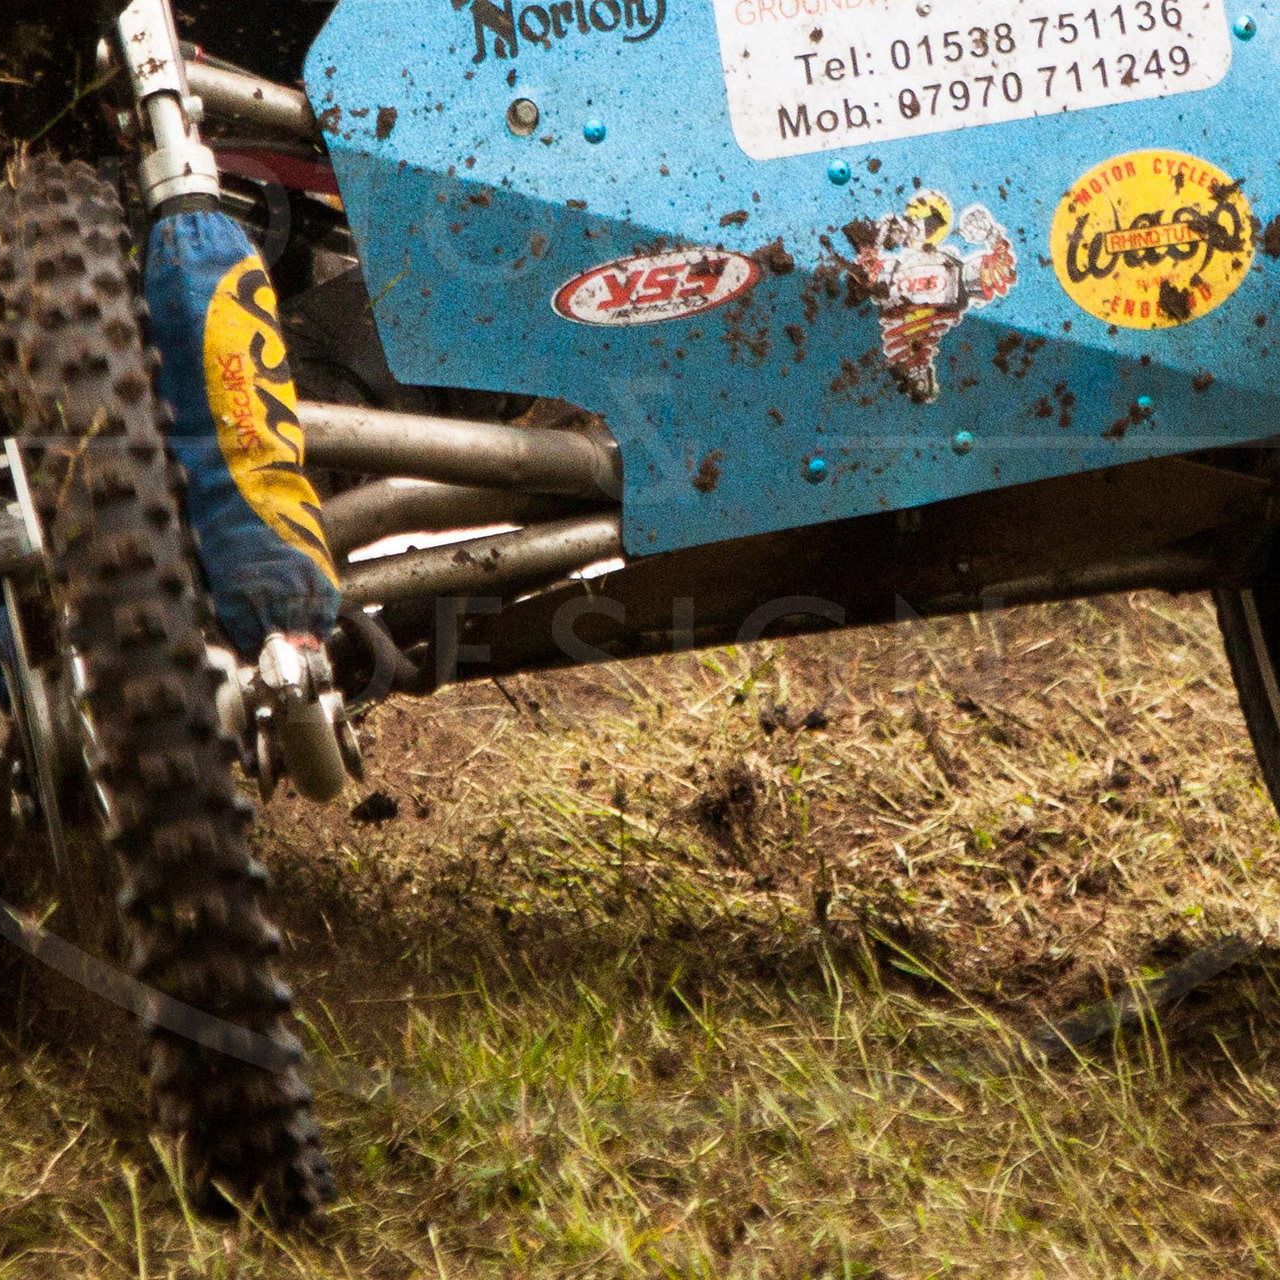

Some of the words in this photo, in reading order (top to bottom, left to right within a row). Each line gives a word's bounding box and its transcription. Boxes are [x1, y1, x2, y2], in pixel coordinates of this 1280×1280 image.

[794, 48, 875, 86] Tel:
[890, 21, 1017, 72] 01538
[778, 99, 882, 140] Mob:
[897, 70, 1024, 120] 07970
[1037, 44, 1192, 99] 711249
[1075, 161, 1138, 207] MOTOR
